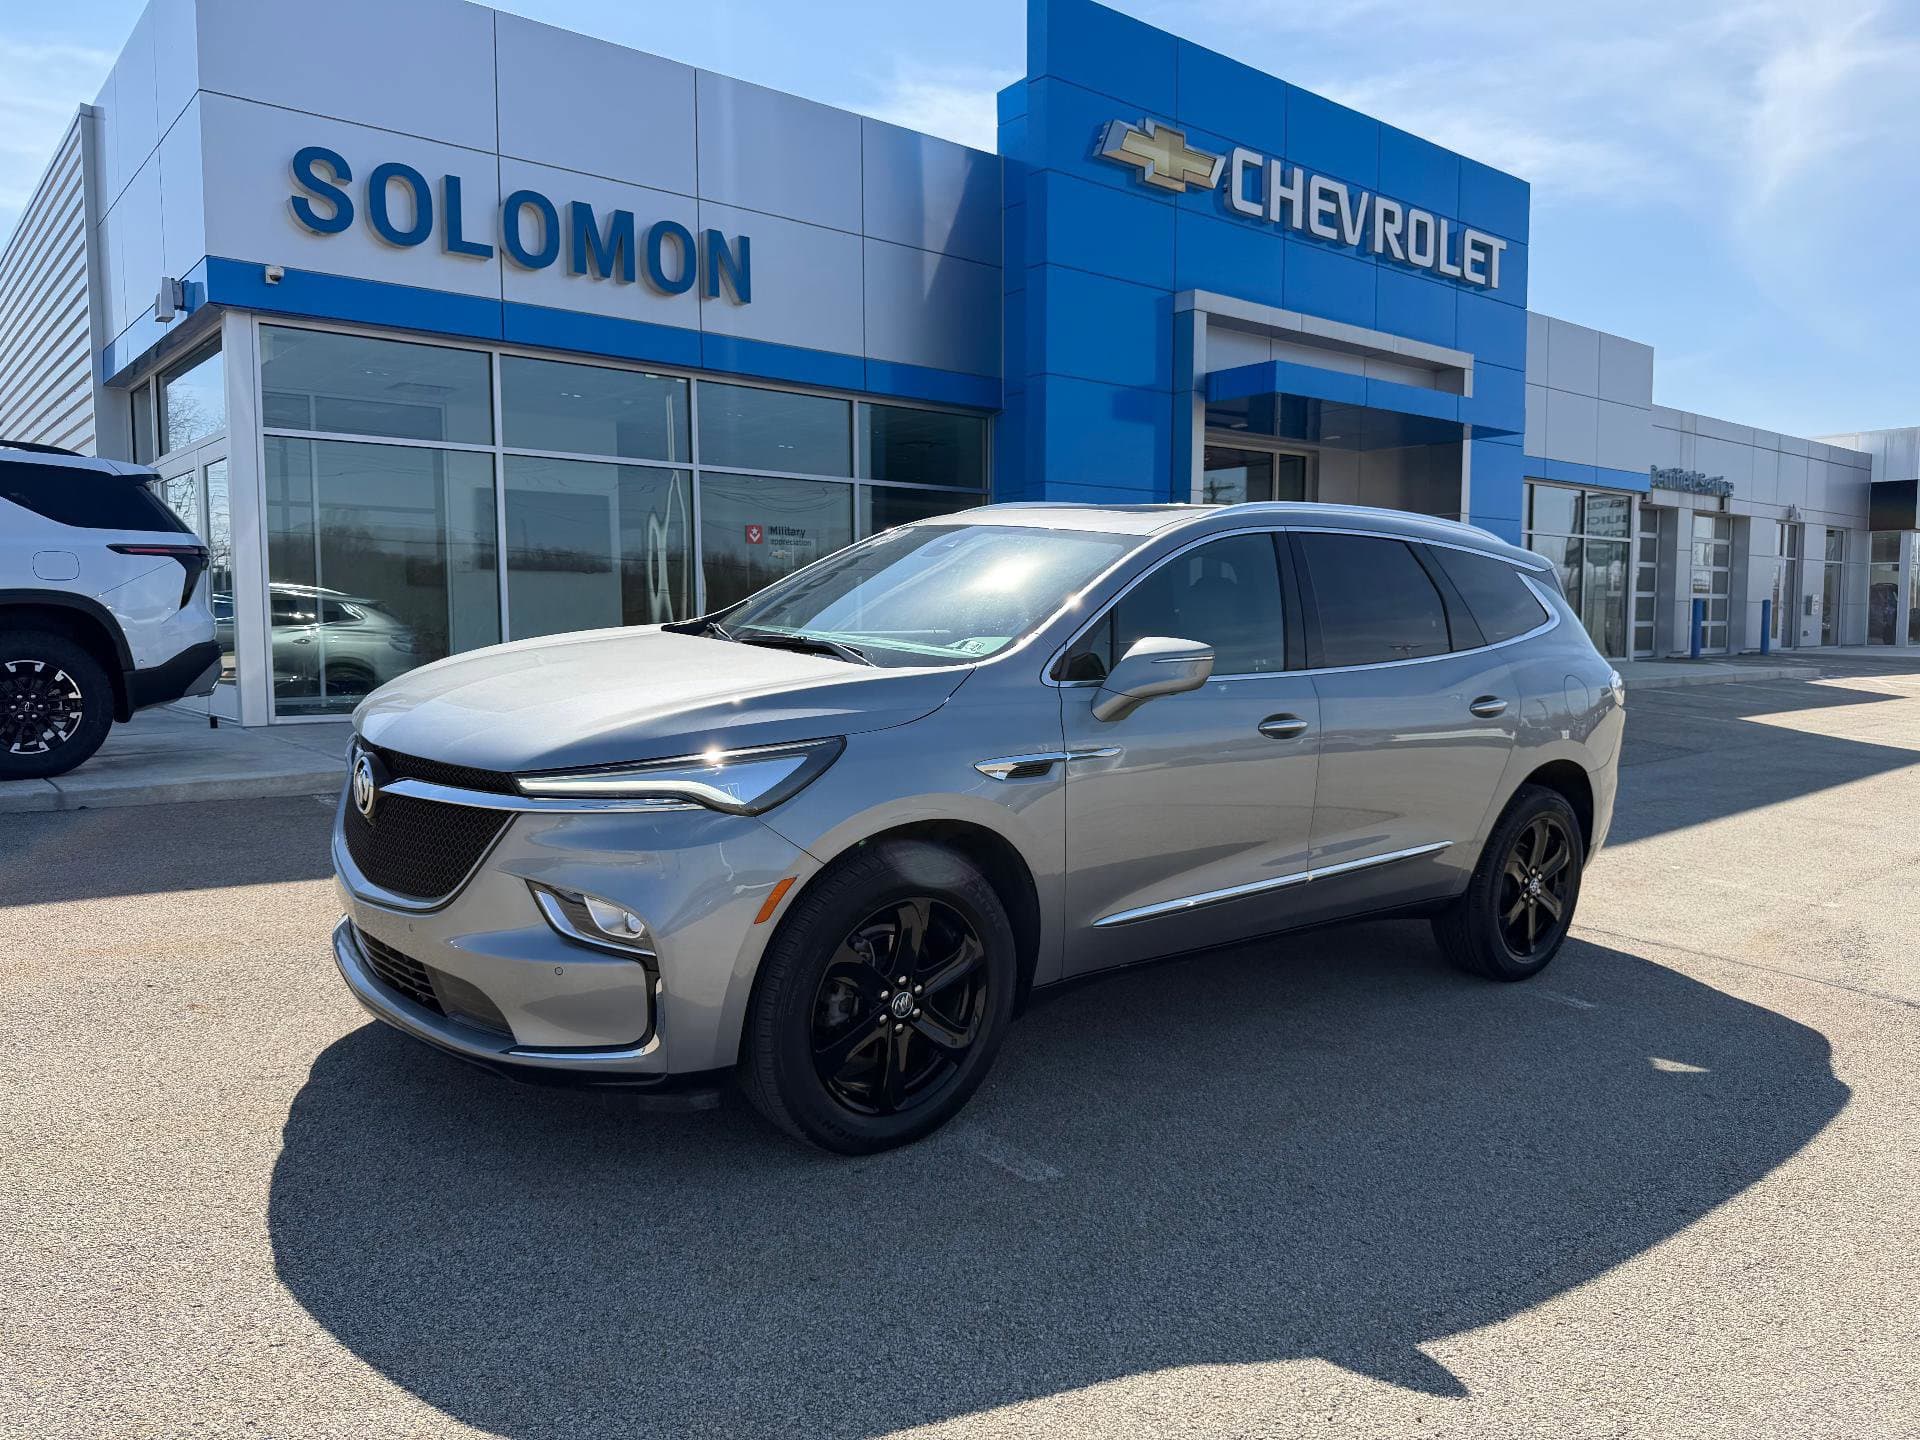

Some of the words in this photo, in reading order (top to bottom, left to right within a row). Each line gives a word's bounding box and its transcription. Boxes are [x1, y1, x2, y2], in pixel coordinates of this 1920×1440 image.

[289, 145, 752, 305] SOLOMON
[1227, 146, 1507, 289] CHEVROLET
[769, 525, 806, 538] Military
